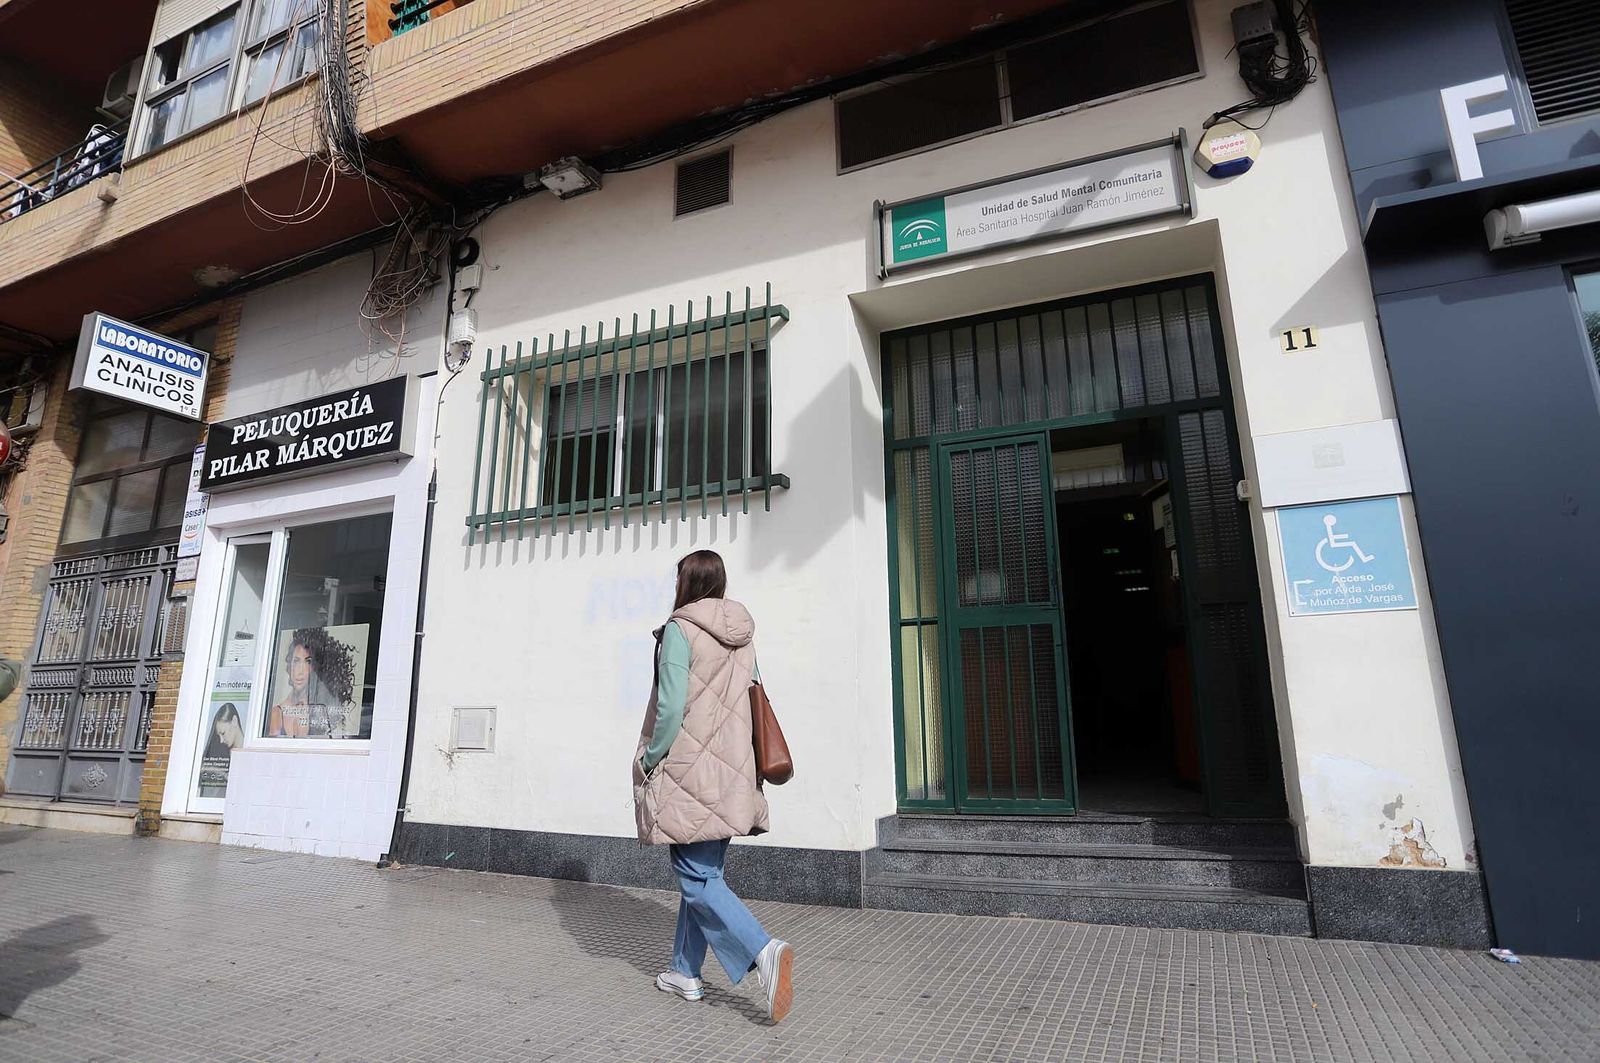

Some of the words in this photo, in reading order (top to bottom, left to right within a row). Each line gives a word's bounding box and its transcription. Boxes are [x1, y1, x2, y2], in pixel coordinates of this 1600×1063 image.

[1440, 74, 1515, 182] F
[979, 217, 1018, 233] Sanitaria
[1020, 208, 1059, 224] Hospital
[1061, 200, 1083, 216] Juan
[1086, 196, 1120, 210] Ramón
[1123, 186, 1165, 203] Jiménez
[981, 201, 1014, 216] Unidad
[1017, 198, 1029, 208] de
[1031, 191, 1058, 205] Salud
[1061, 183, 1096, 200] Mental
[1099, 169, 1162, 190] Comunitaria
[100, 325, 202, 371] LABORATORIO
[1283, 327, 1317, 350] 11
[97, 368, 194, 406] CLINICOS
[100, 354, 195, 392] ANALISIS
[191, 408, 198, 416] E
[231, 391, 374, 445] PELUQUERÍA
[208, 449, 270, 479] PILAR
[275, 421, 394, 466] MÁRQUEZ
[1315, 587, 1332, 597] por
[1369, 582, 1394, 592] José
[1331, 574, 1374, 584] Acceso
[1310, 597, 1346, 607] Muñoz
[1349, 594, 1362, 604] de
[1364, 593, 1404, 605] Vargas
